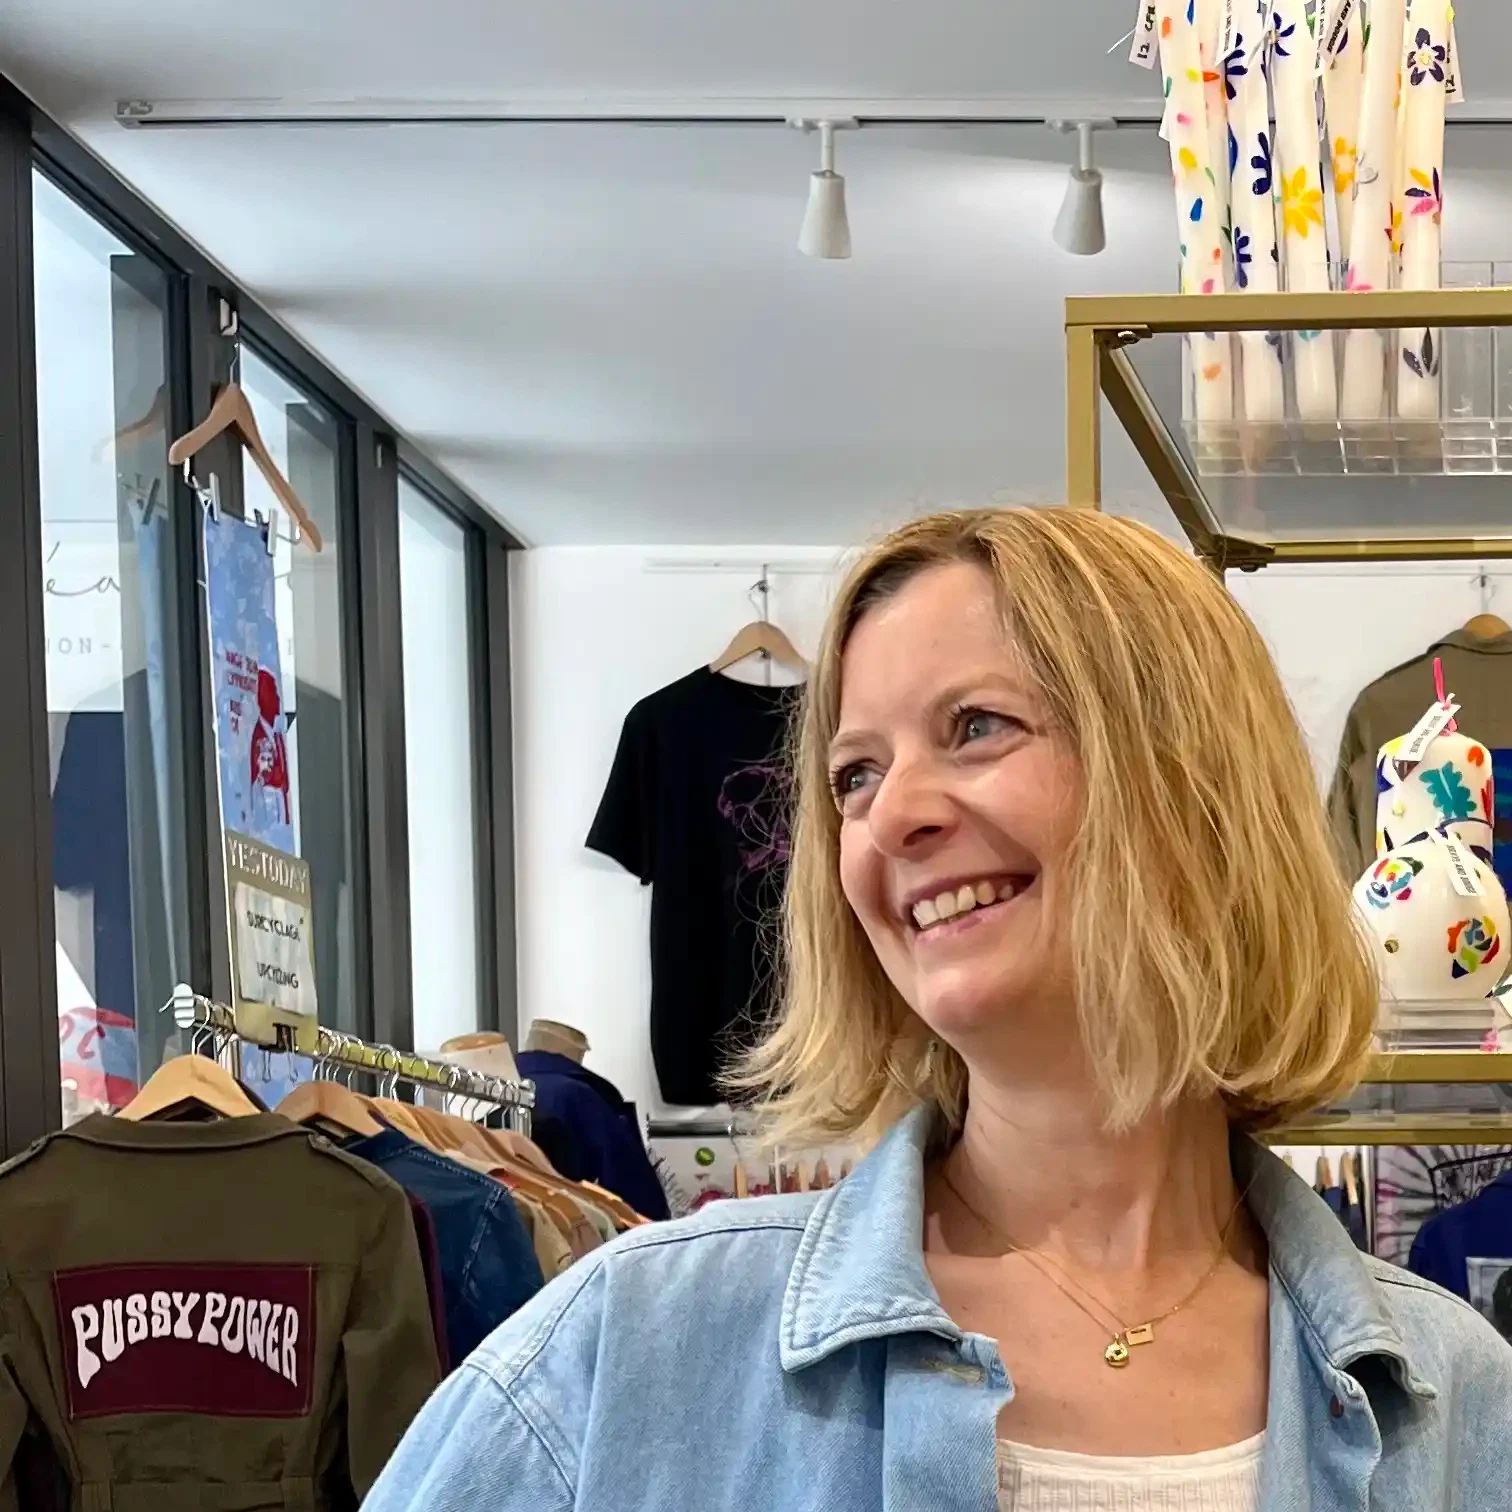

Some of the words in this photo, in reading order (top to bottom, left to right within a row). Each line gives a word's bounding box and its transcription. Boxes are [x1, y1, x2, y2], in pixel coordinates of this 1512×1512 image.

[227, 837, 309, 894] YESTODAY
[71, 1290, 201, 1389] PUSSY
[197, 1291, 299, 1388] POWER
